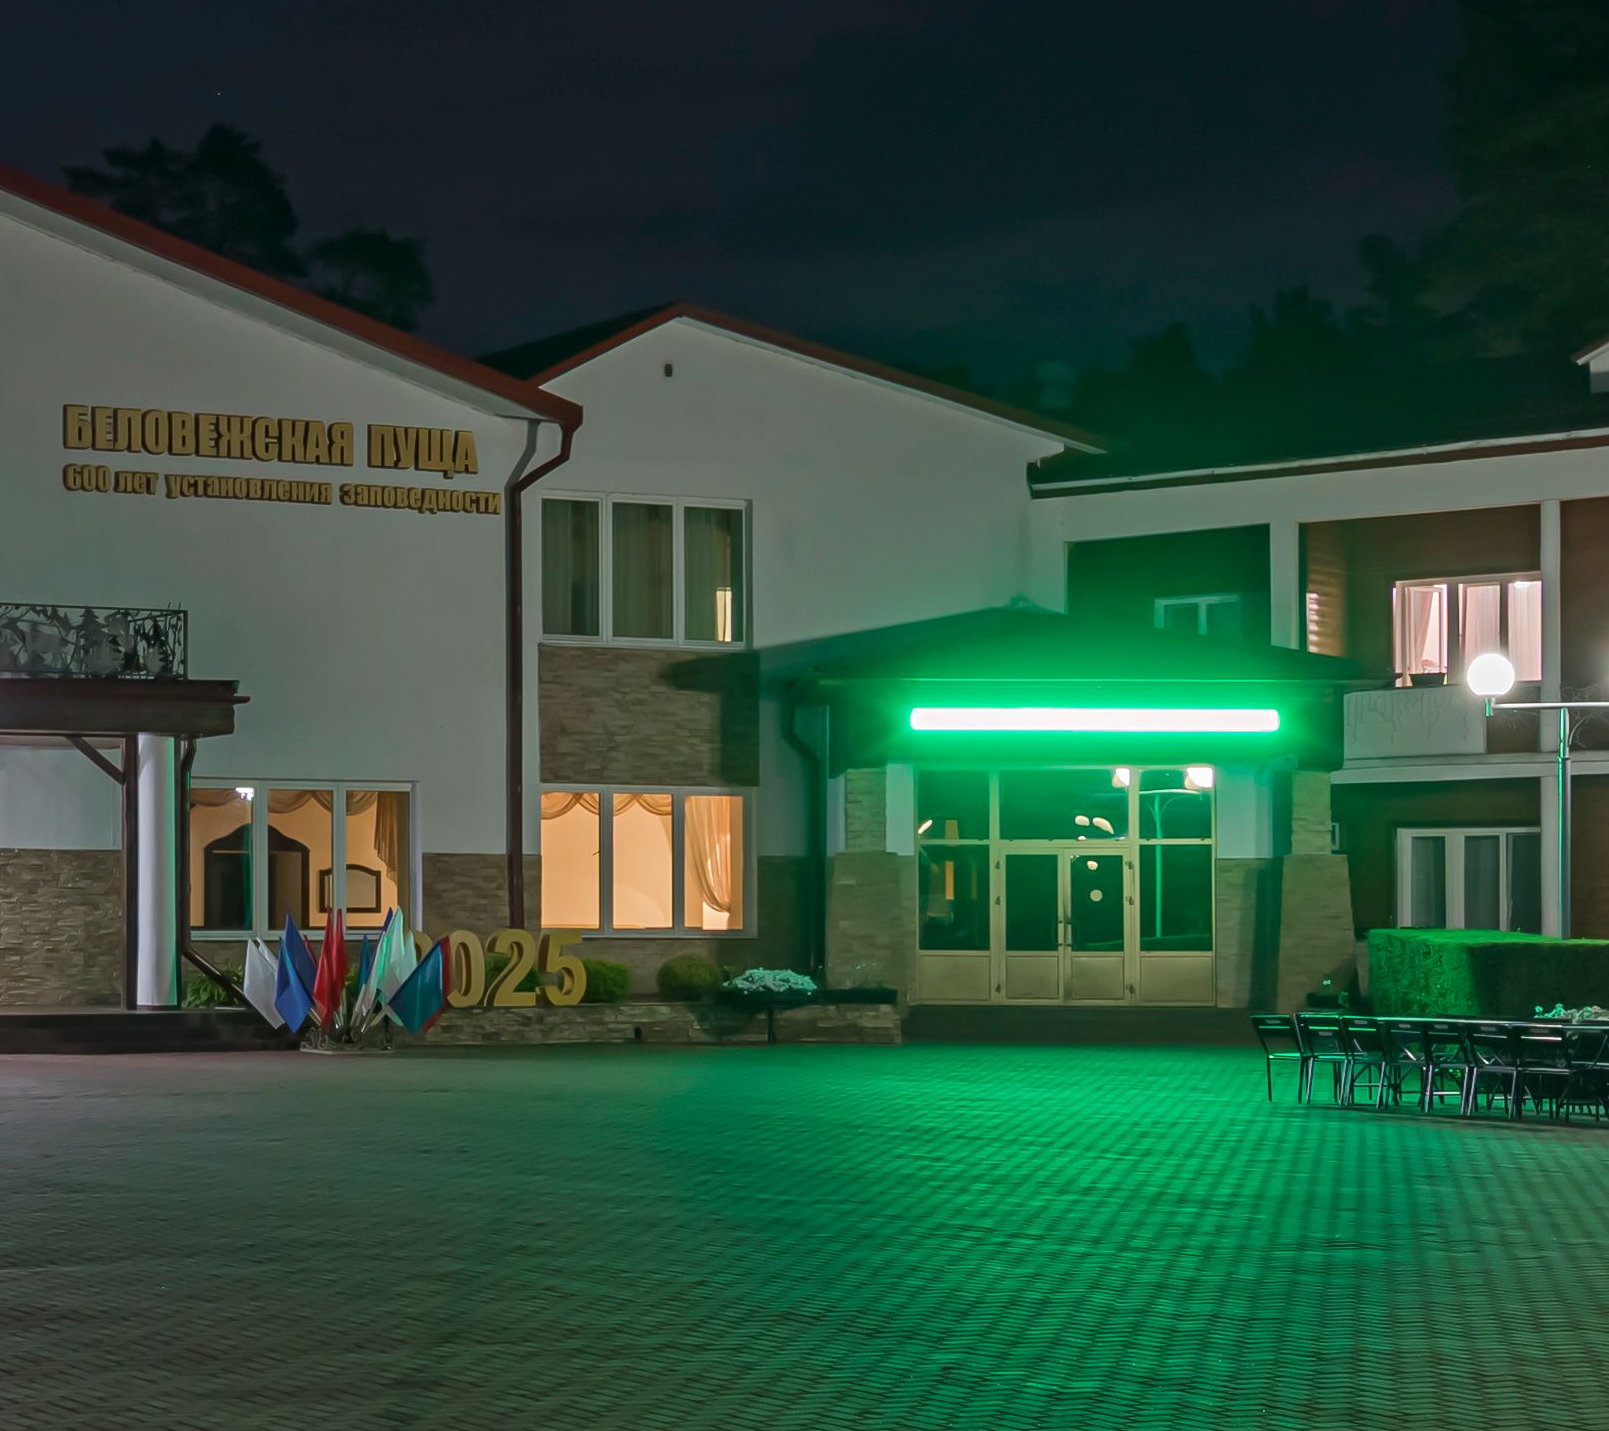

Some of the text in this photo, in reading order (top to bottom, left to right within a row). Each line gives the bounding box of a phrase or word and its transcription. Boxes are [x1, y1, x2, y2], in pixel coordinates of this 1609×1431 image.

[63, 404, 479, 479] БЕЛОВЕЖСКАЯ ПУЩА
[63, 464, 502, 515] 600 лет установления заповедности
[414, 928, 587, 1008] 025
